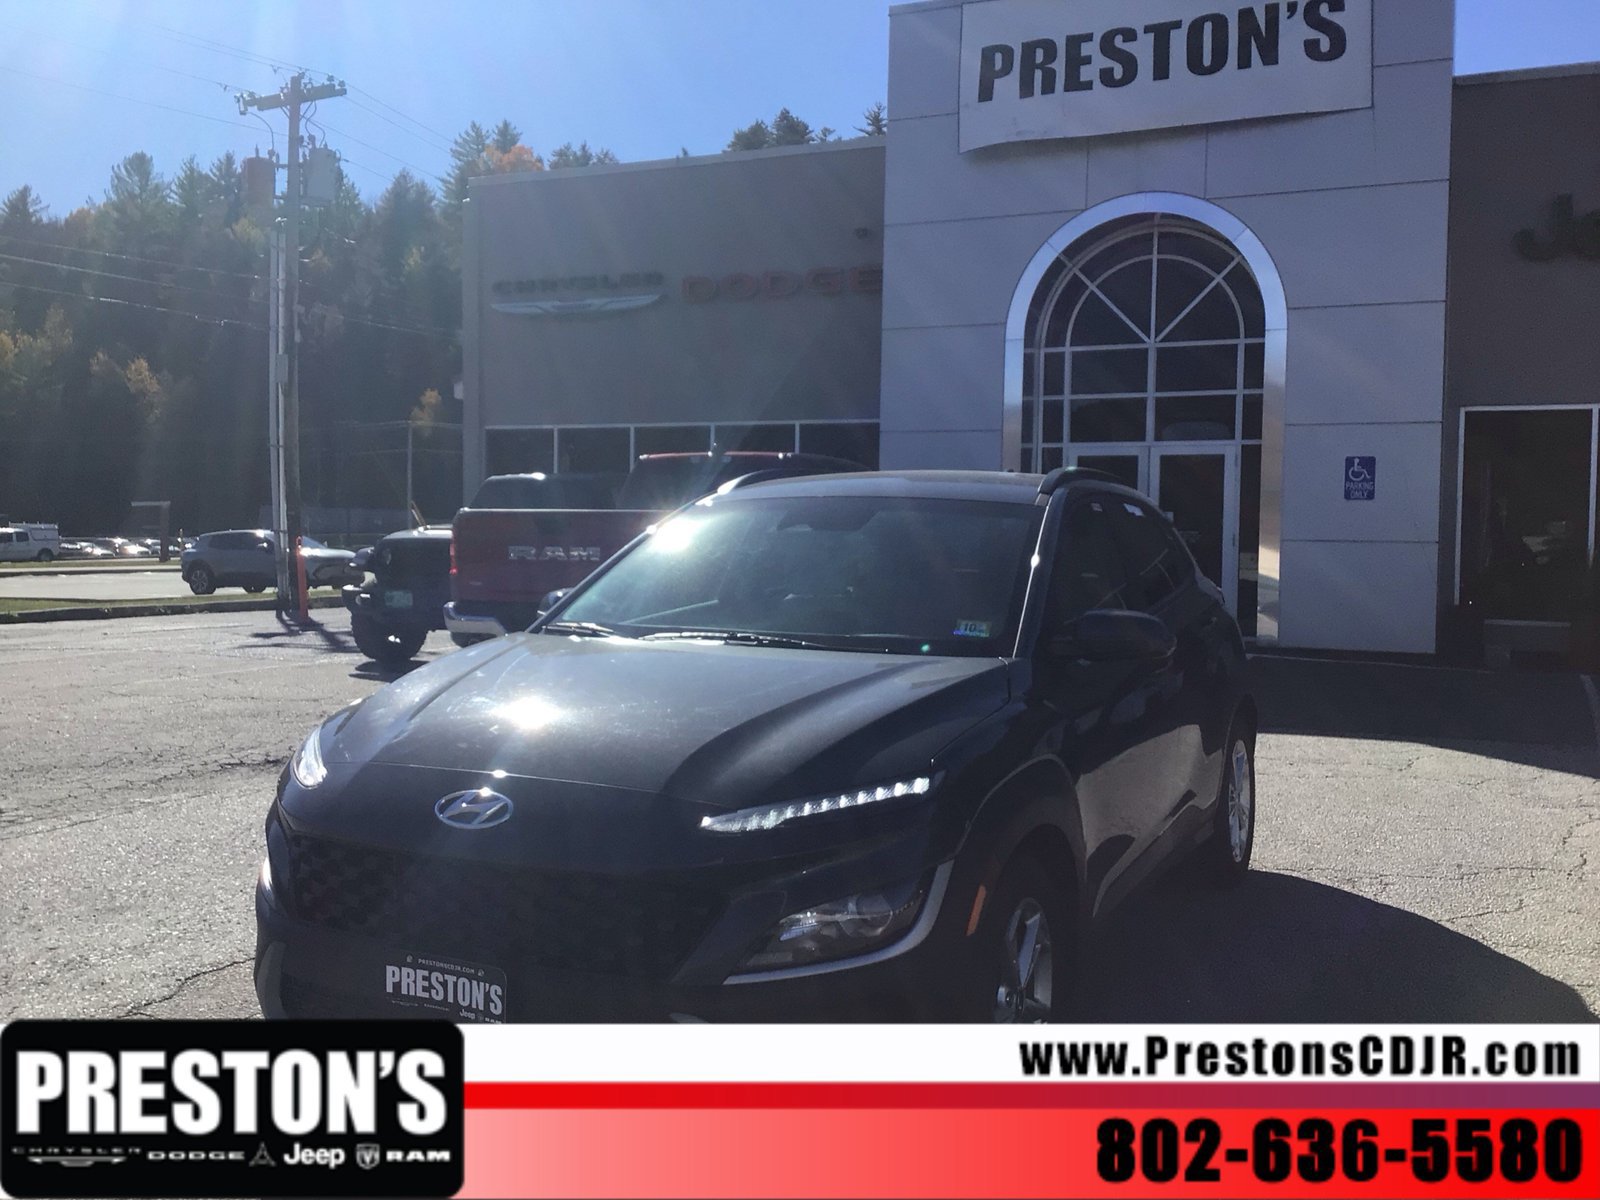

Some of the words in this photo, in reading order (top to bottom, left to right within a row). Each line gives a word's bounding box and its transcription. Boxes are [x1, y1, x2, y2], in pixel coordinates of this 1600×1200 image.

[977, 0, 1347, 103] PRESTON'S
[682, 262, 882, 302] DODGE
[1345, 481, 1374, 490] PARKING
[508, 545, 601, 561] RAM
[385, 965, 503, 1016] PRESTON'S
